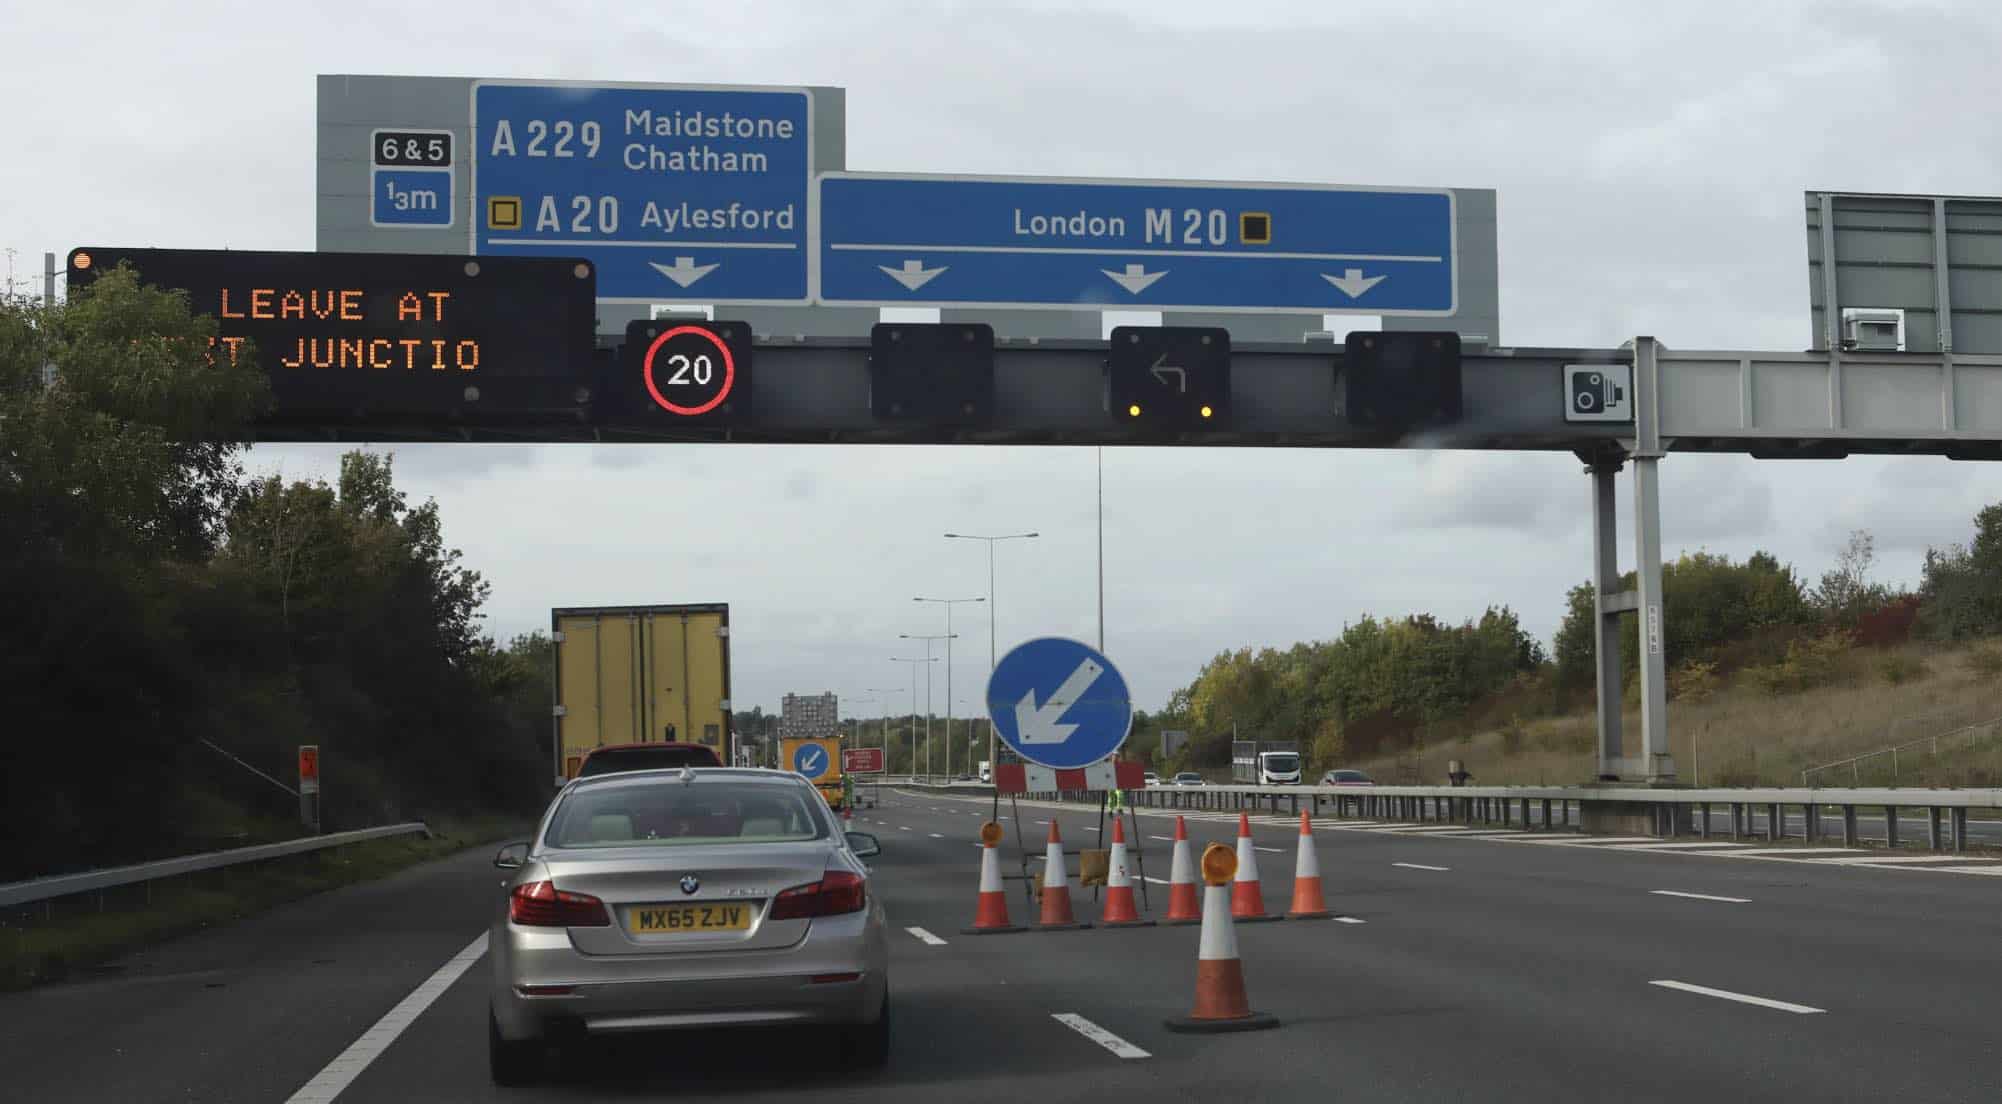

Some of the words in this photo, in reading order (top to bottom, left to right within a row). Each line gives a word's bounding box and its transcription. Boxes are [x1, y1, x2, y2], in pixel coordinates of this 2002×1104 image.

[625, 109, 794, 138] Maidstone
[623, 143, 768, 172] Chatham
[640, 201, 794, 233] Aylesford
[1015, 208, 1125, 237] London
[221, 287, 363, 321] LEAVE
[398, 290, 450, 321] AT
[281, 337, 480, 370] JUNCTIO
[667, 354, 712, 385] 20
[640, 909, 695, 930] MX65
[701, 907, 741, 927] ZJV
